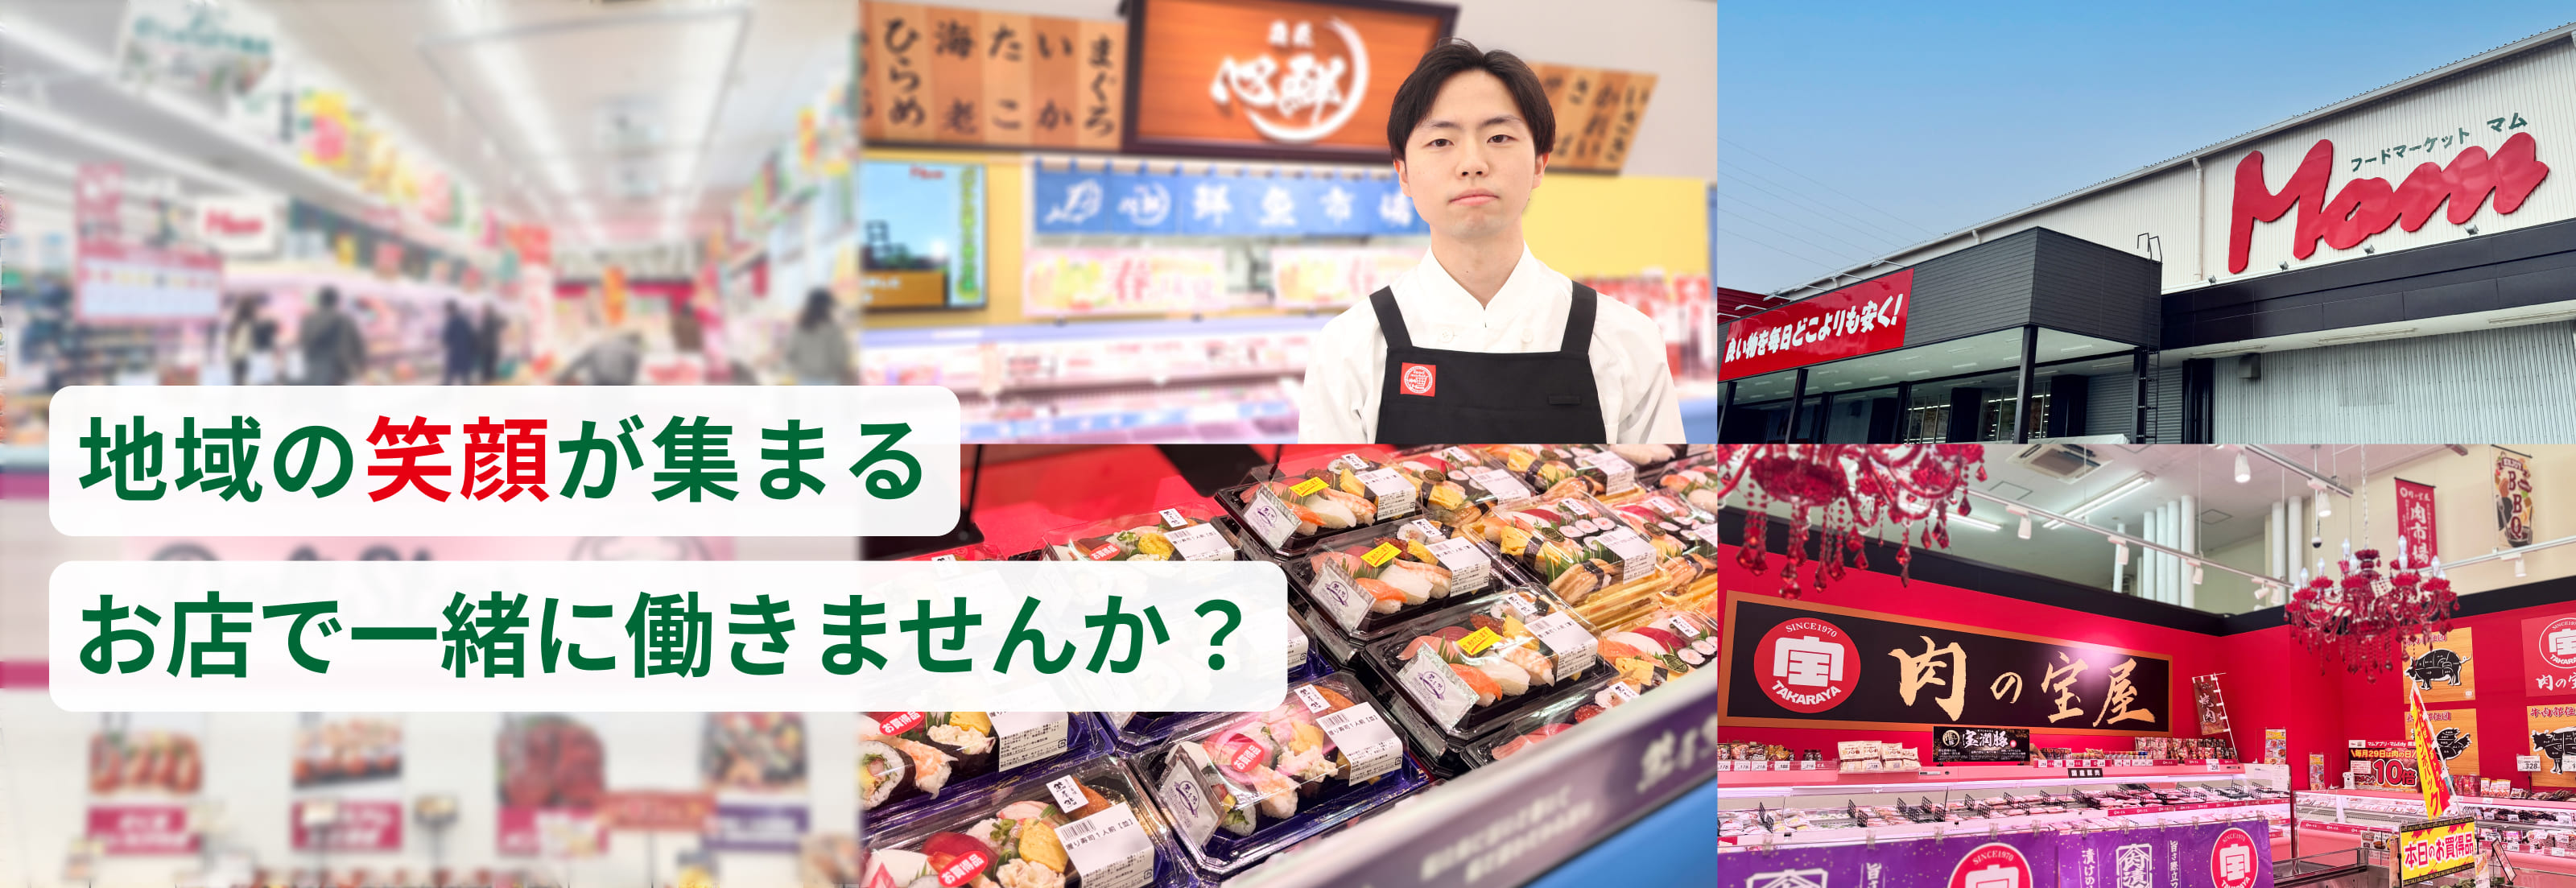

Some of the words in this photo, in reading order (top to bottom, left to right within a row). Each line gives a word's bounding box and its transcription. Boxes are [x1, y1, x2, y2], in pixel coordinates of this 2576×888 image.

[987, 23, 1023, 130] たこ
[1038, 32, 1074, 131] いか
[1084, 33, 1117, 138] まぐろ
[2351, 127, 2470, 172] フードマーケット
[2487, 113, 2528, 132] マム
[2409, 501, 2429, 564] 肉市場
[1785, 622, 1838, 638] SINCE1970
[1772, 679, 1842, 705] TAKARAYA
[1888, 634, 2156, 727] 肉の宝屋
[881, 710, 921, 733] お買得品
[2198, 692, 2217, 724] 焼肉
[941, 853, 985, 886] お買得品
[1971, 849, 2015, 866] SINCE1970
[2081, 848, 2095, 888] 漬けの
[2404, 832, 2475, 869] 本日のお買得品
